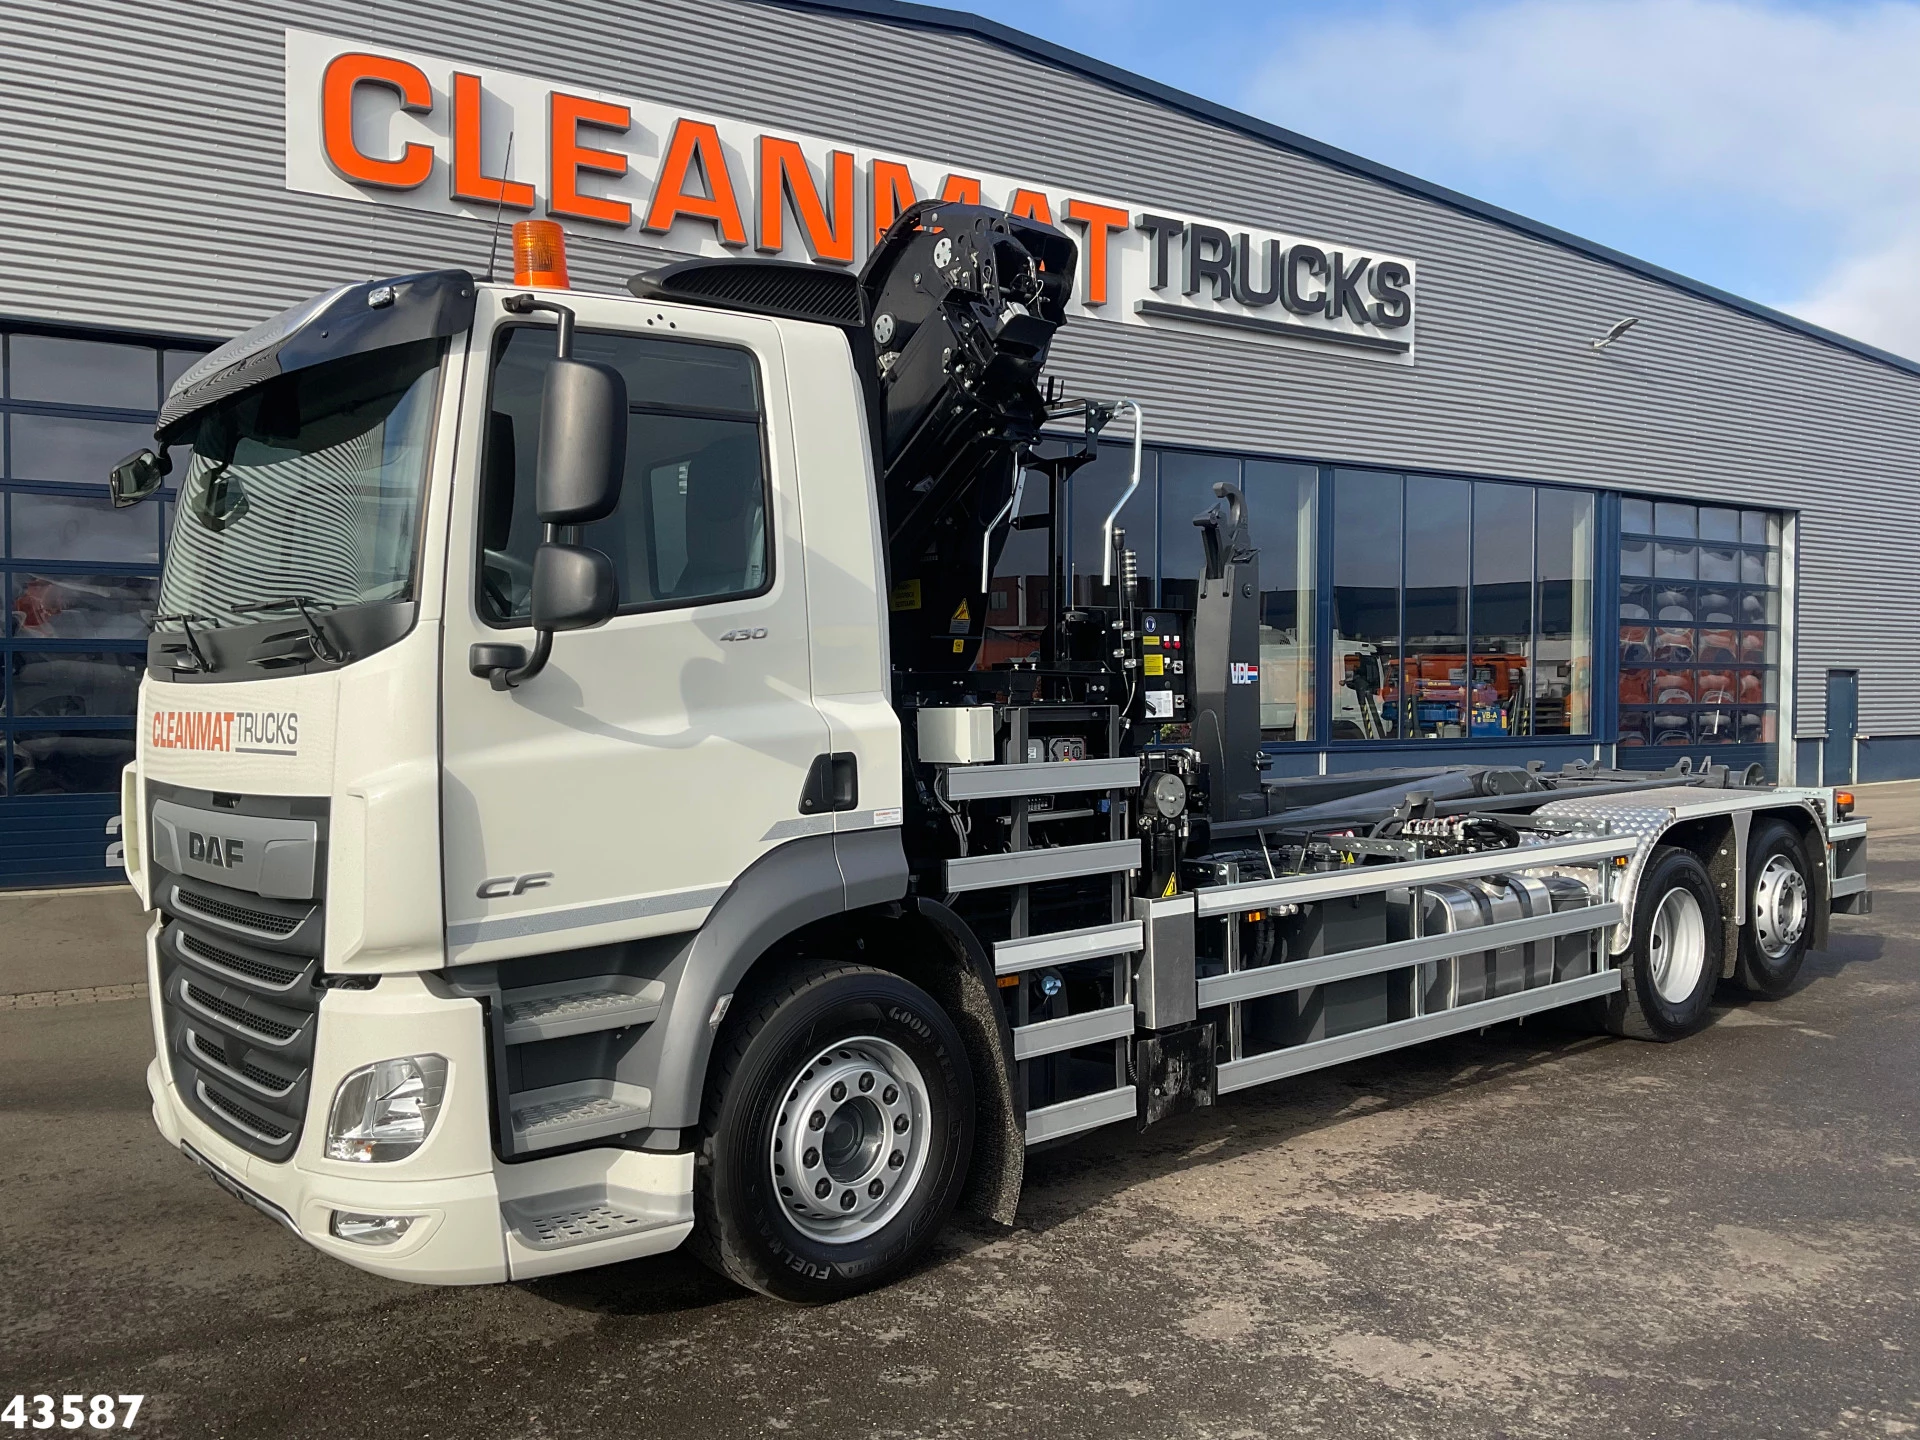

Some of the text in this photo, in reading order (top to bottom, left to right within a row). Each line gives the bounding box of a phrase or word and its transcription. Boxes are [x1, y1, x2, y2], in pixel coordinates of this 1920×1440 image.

[1135, 213, 1411, 328] TRUCKS
[720, 627, 769, 642] 430
[1230, 662, 1252, 684] VDL
[152, 711, 298, 752] CLEANMAT TRUCKS
[188, 831, 244, 869] DAF
[475, 872, 554, 899] CF
